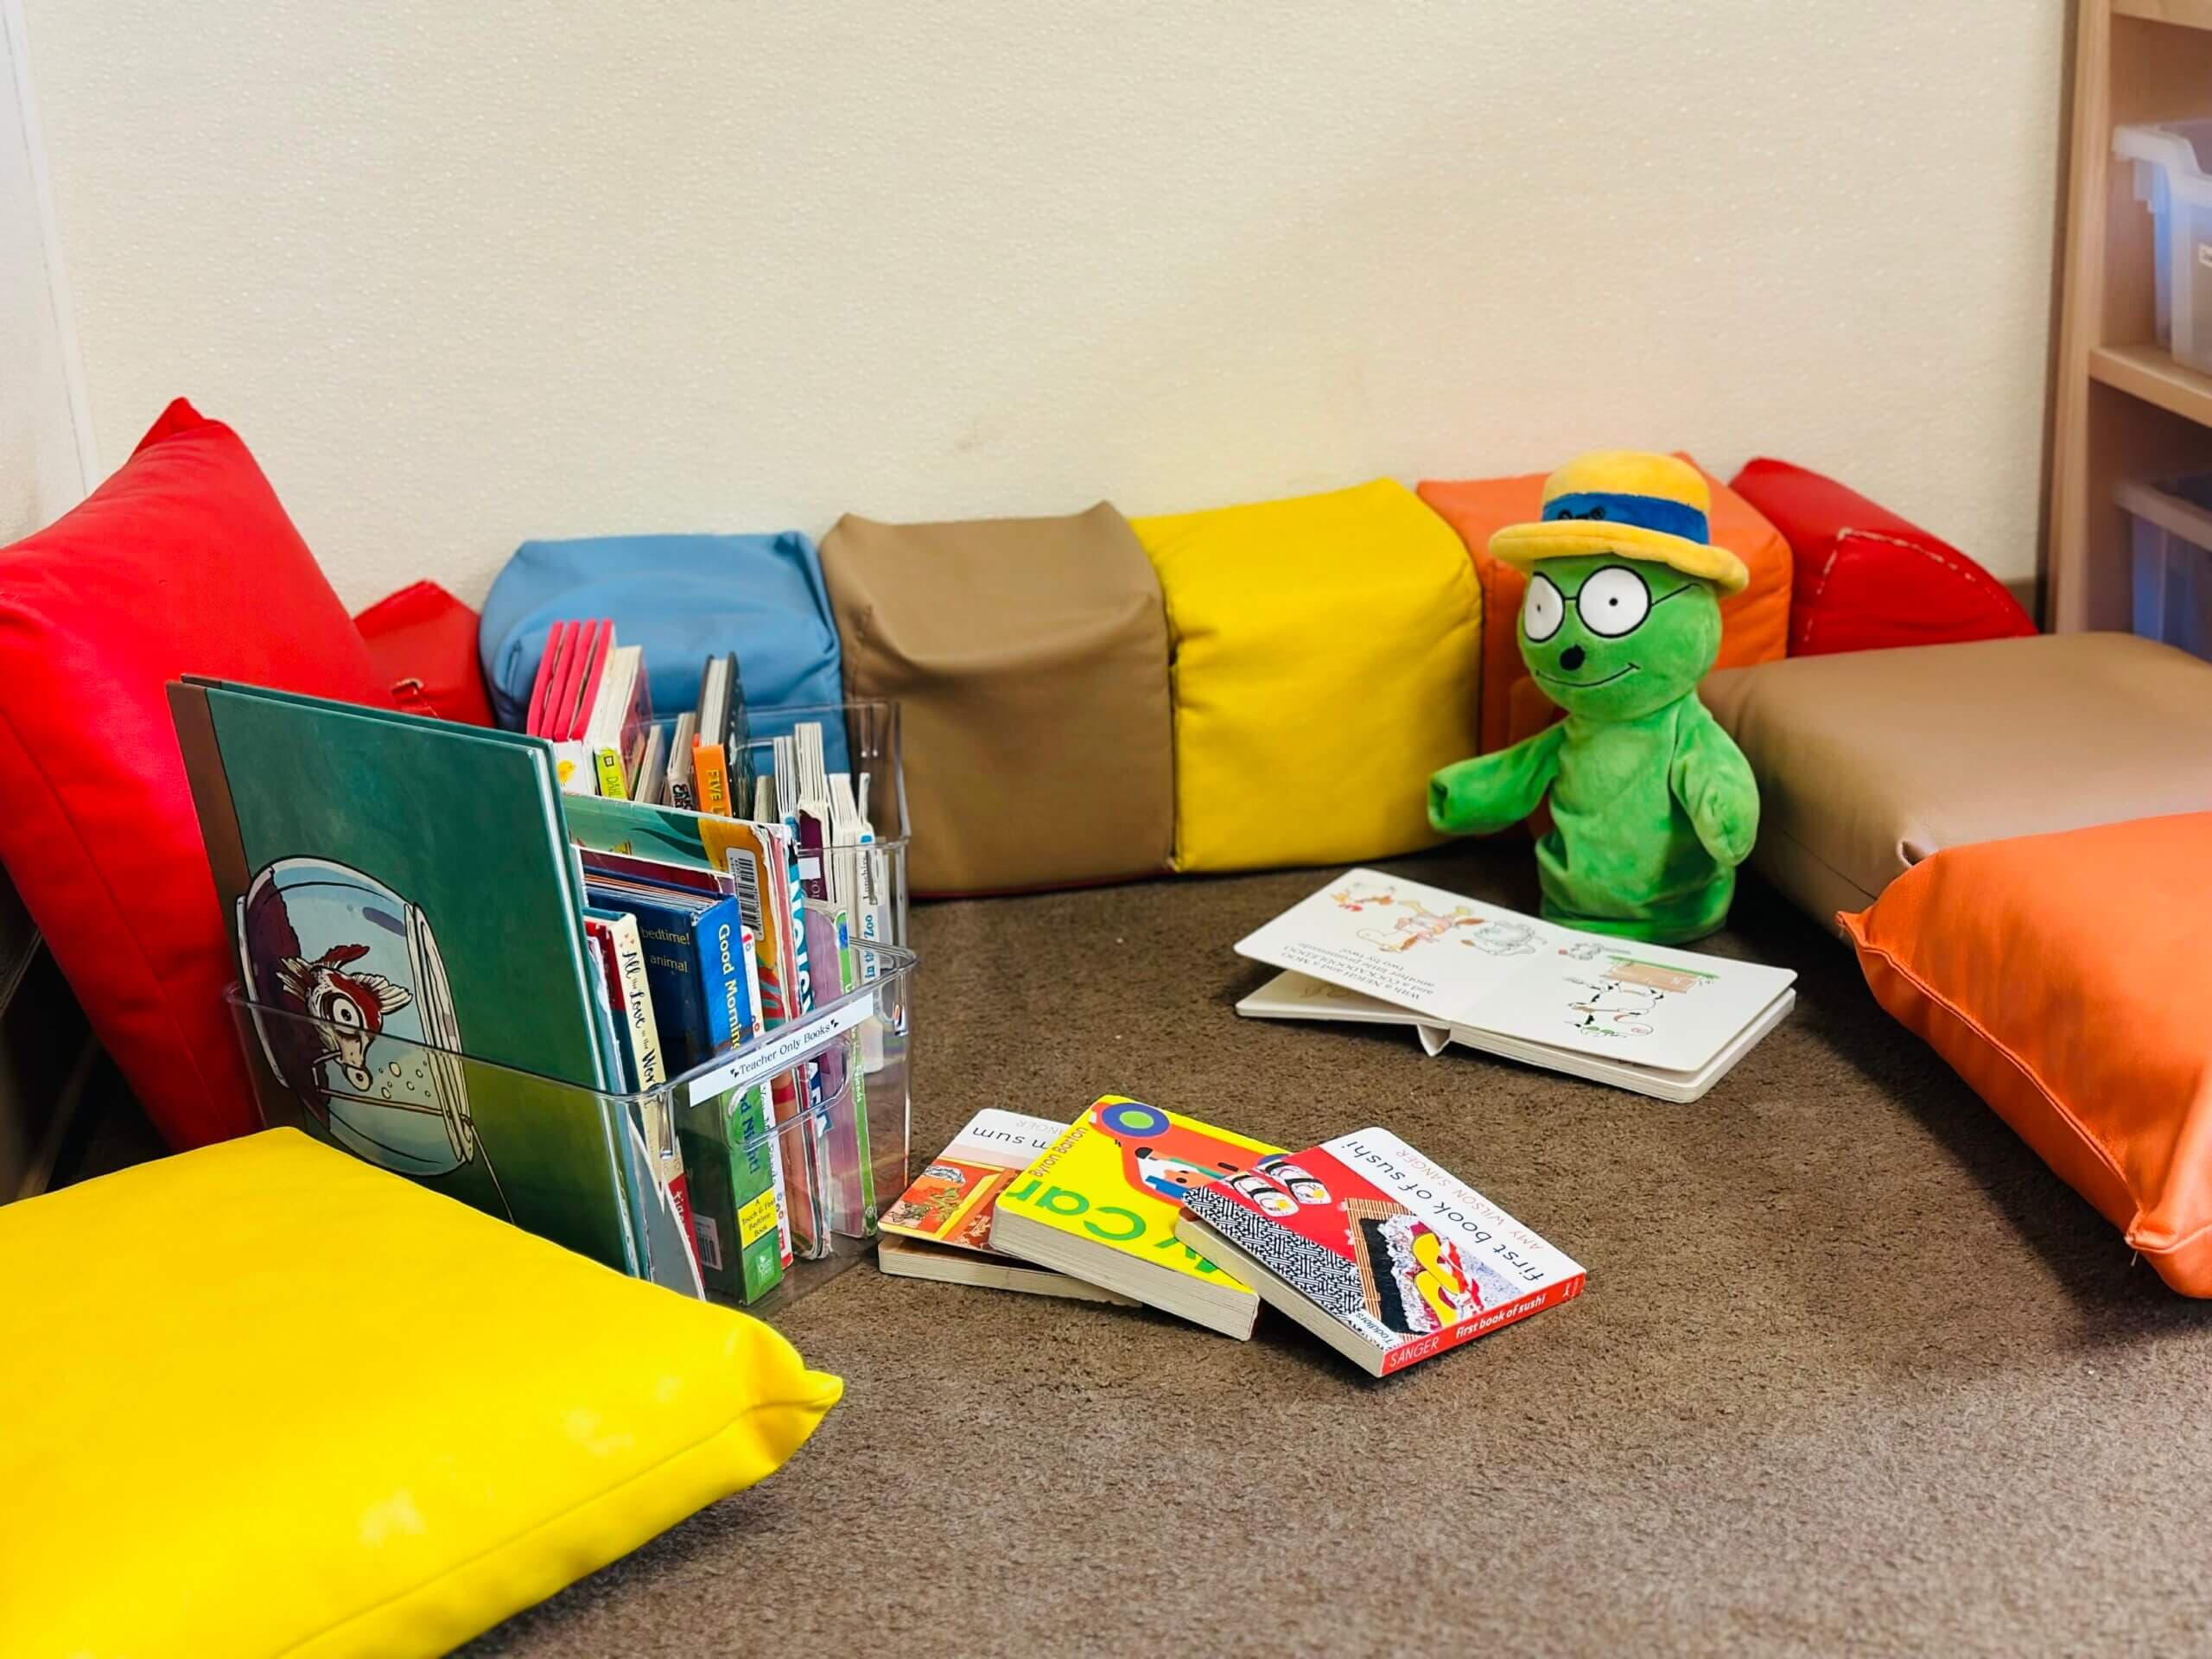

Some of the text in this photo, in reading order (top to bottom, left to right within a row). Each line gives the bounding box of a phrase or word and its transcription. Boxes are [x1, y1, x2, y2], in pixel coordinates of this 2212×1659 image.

[706, 770, 722, 802] FIVE
[641, 926, 690, 945] bedtime!
[719, 924, 734, 976] Good
[864, 914, 875, 978] in th Zoo
[622, 950, 640, 979] All
[650, 954, 688, 973] animal
[629, 991, 645, 1028] Love
[739, 1022, 830, 1075] Teacher Only Books
[742, 1116, 760, 1174] Niht!
[973, 1127, 1026, 1144] sum
[1016, 1120, 1065, 1135] ANGER
[1028, 1127, 1089, 1178] Byron Barton
[1005, 1179, 1146, 1241] Car
[1341, 1141, 1544, 1281] first book of sushi
[1396, 1149, 1544, 1250] AMY WILSON SANGER
[1389, 1294, 1546, 1368] SANGER first book of sushi
